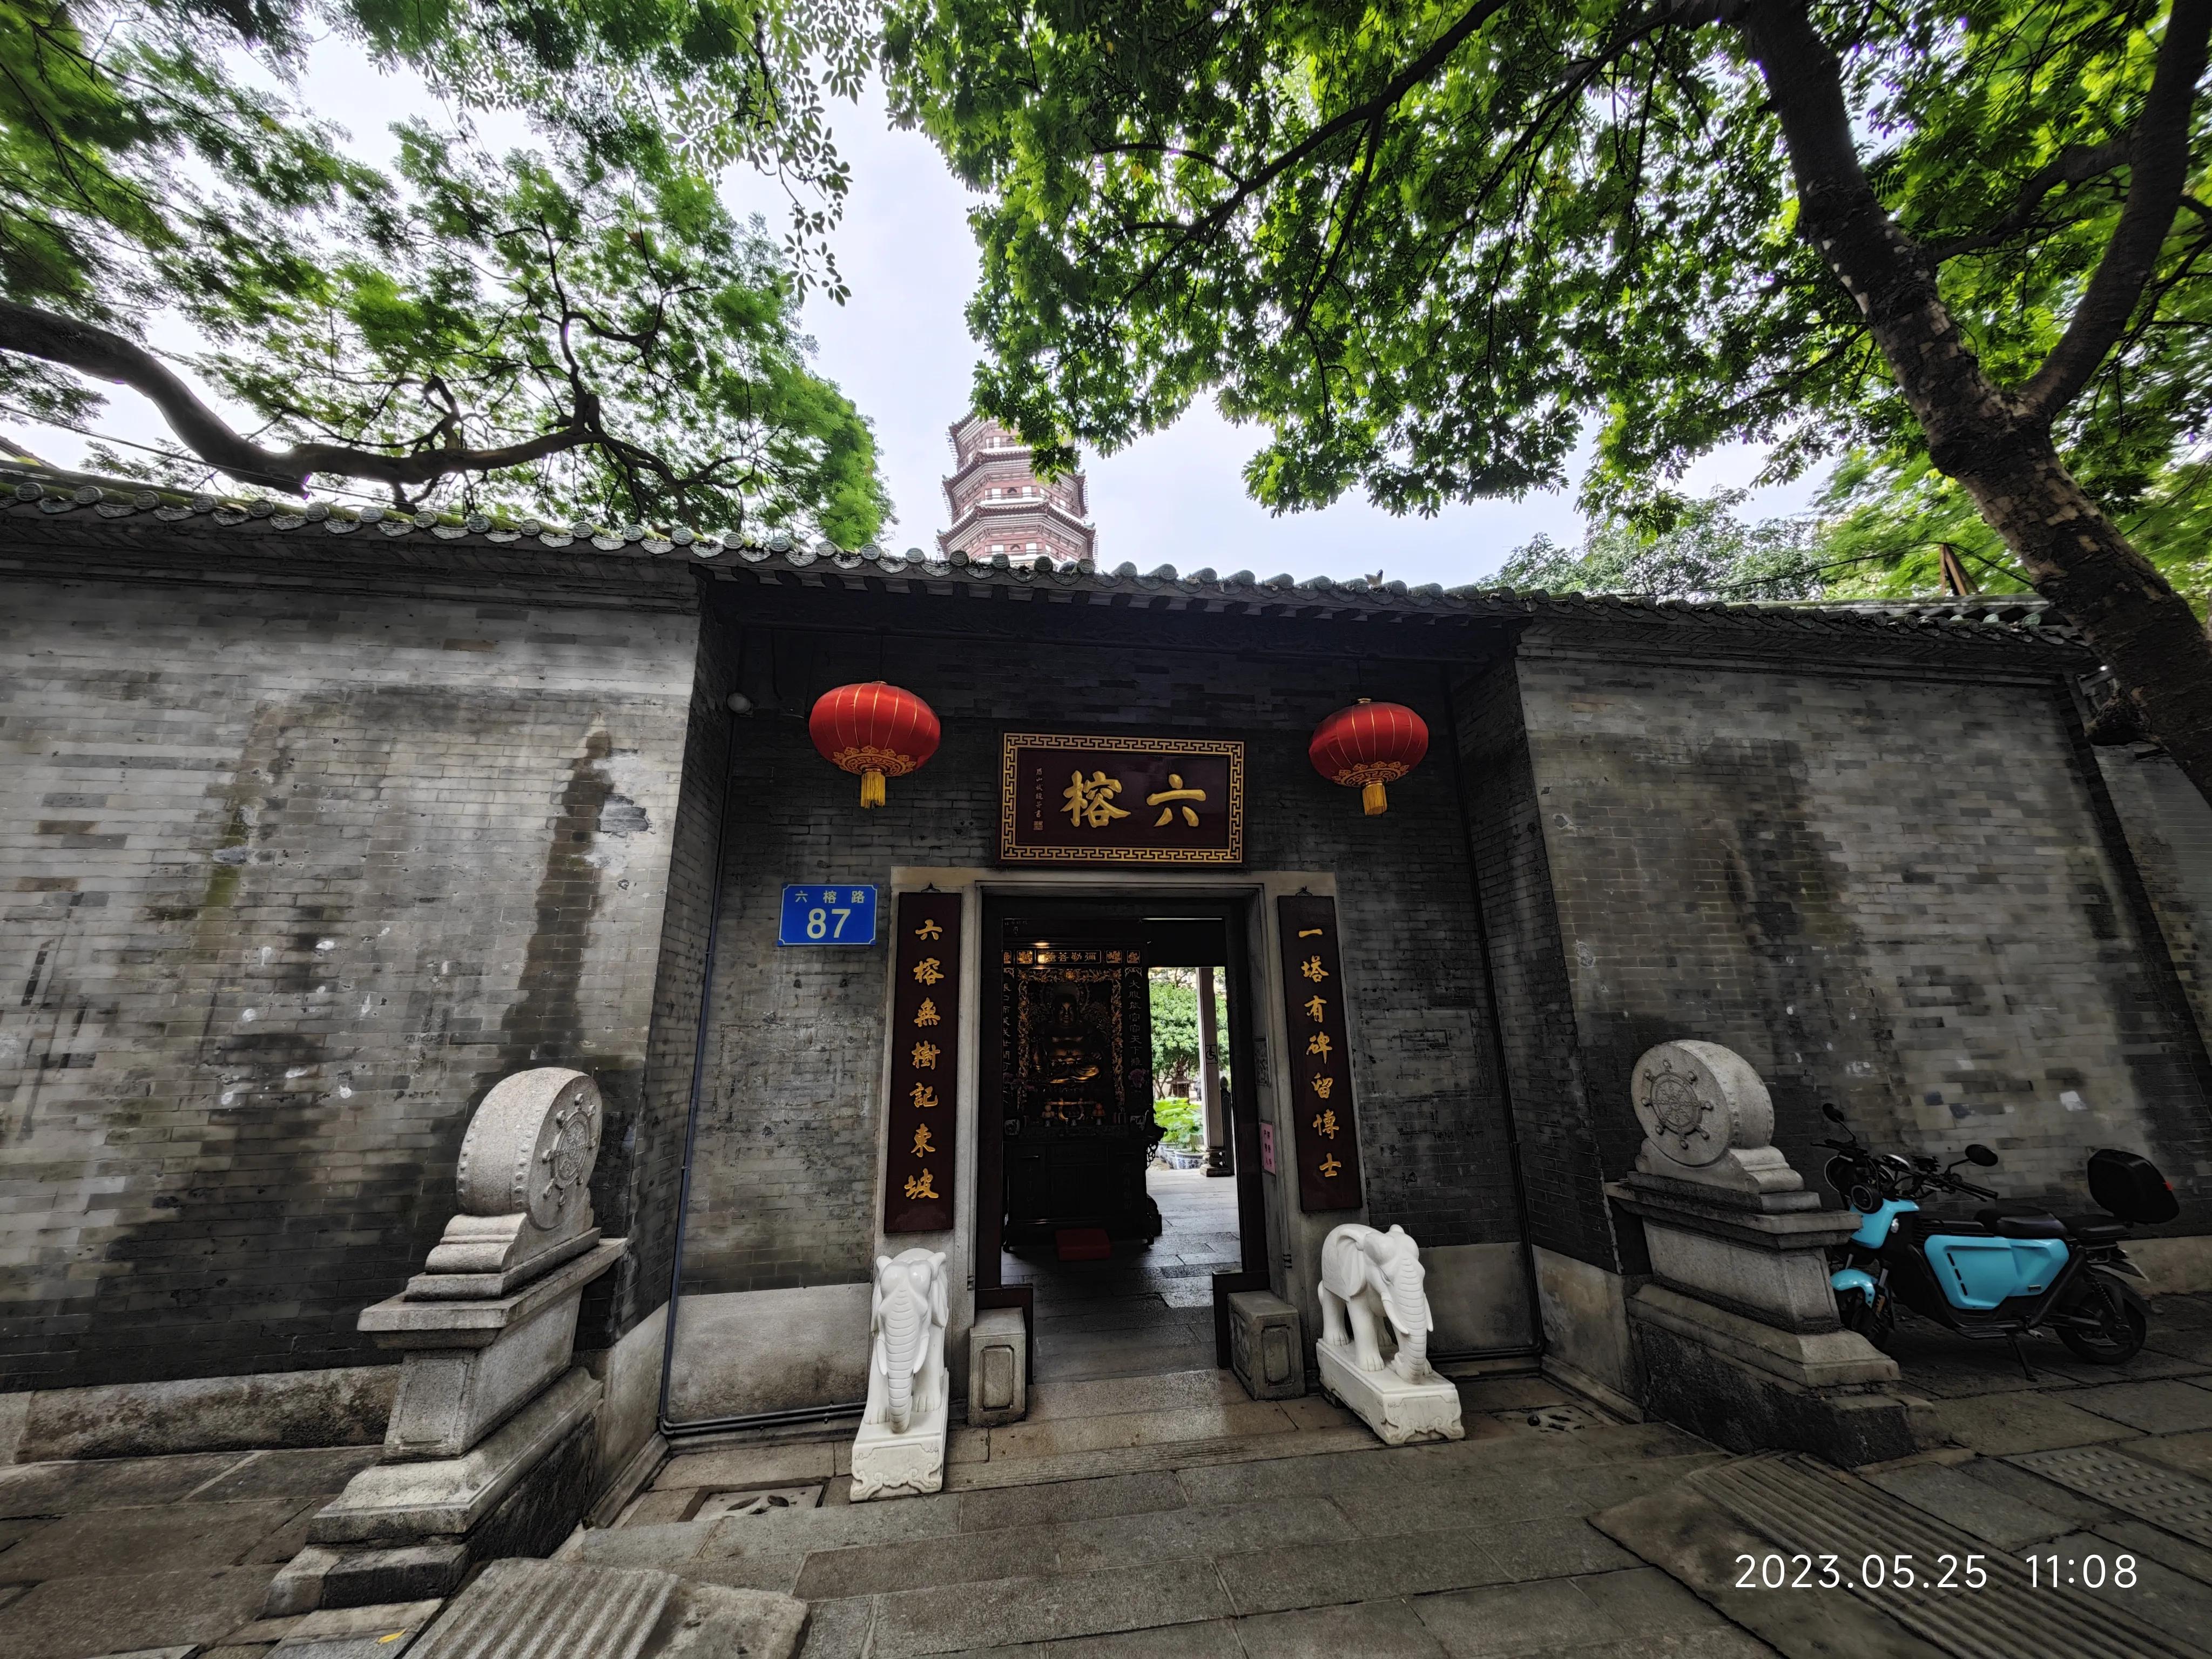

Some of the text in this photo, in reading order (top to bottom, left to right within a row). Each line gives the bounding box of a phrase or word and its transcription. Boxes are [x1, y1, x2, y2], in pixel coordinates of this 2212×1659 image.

[1060, 770, 1206, 828] 六榕
[795, 890, 865, 904] 六榕路
[807, 908, 852, 939] 87
[905, 919, 944, 1200] 六榕無樹記東坡
